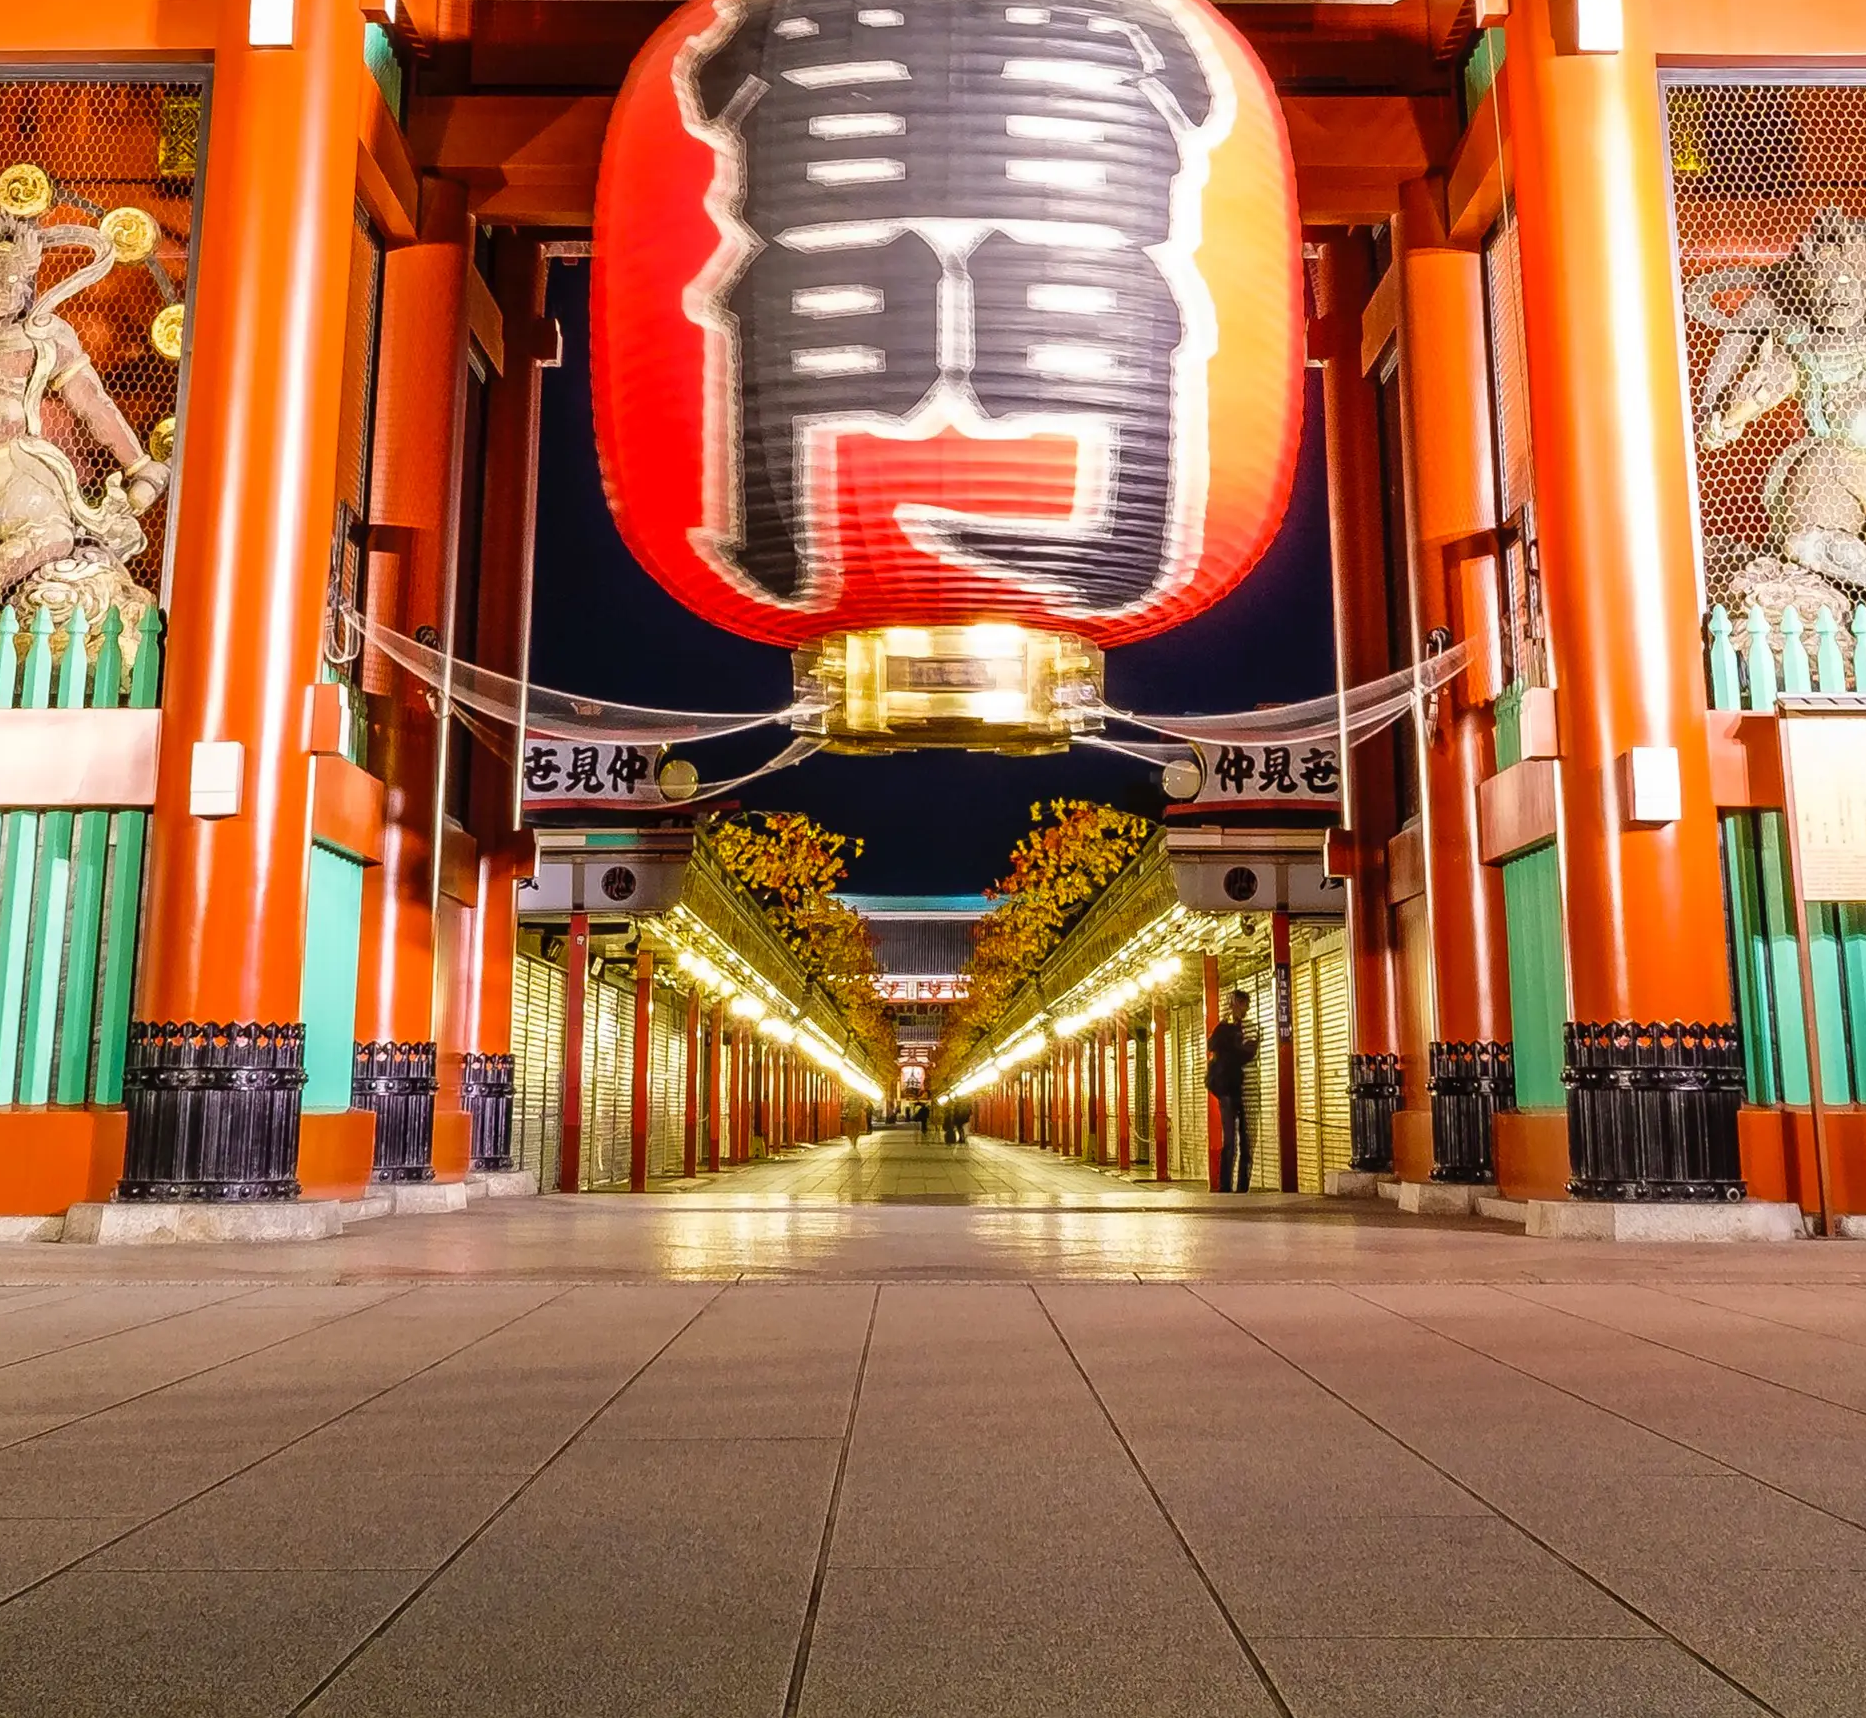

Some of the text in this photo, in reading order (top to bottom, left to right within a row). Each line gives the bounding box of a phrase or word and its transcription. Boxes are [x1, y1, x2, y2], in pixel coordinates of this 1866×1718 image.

[524, 746, 649, 794] 仲見世
[1215, 746, 1340, 794] 仲見世
